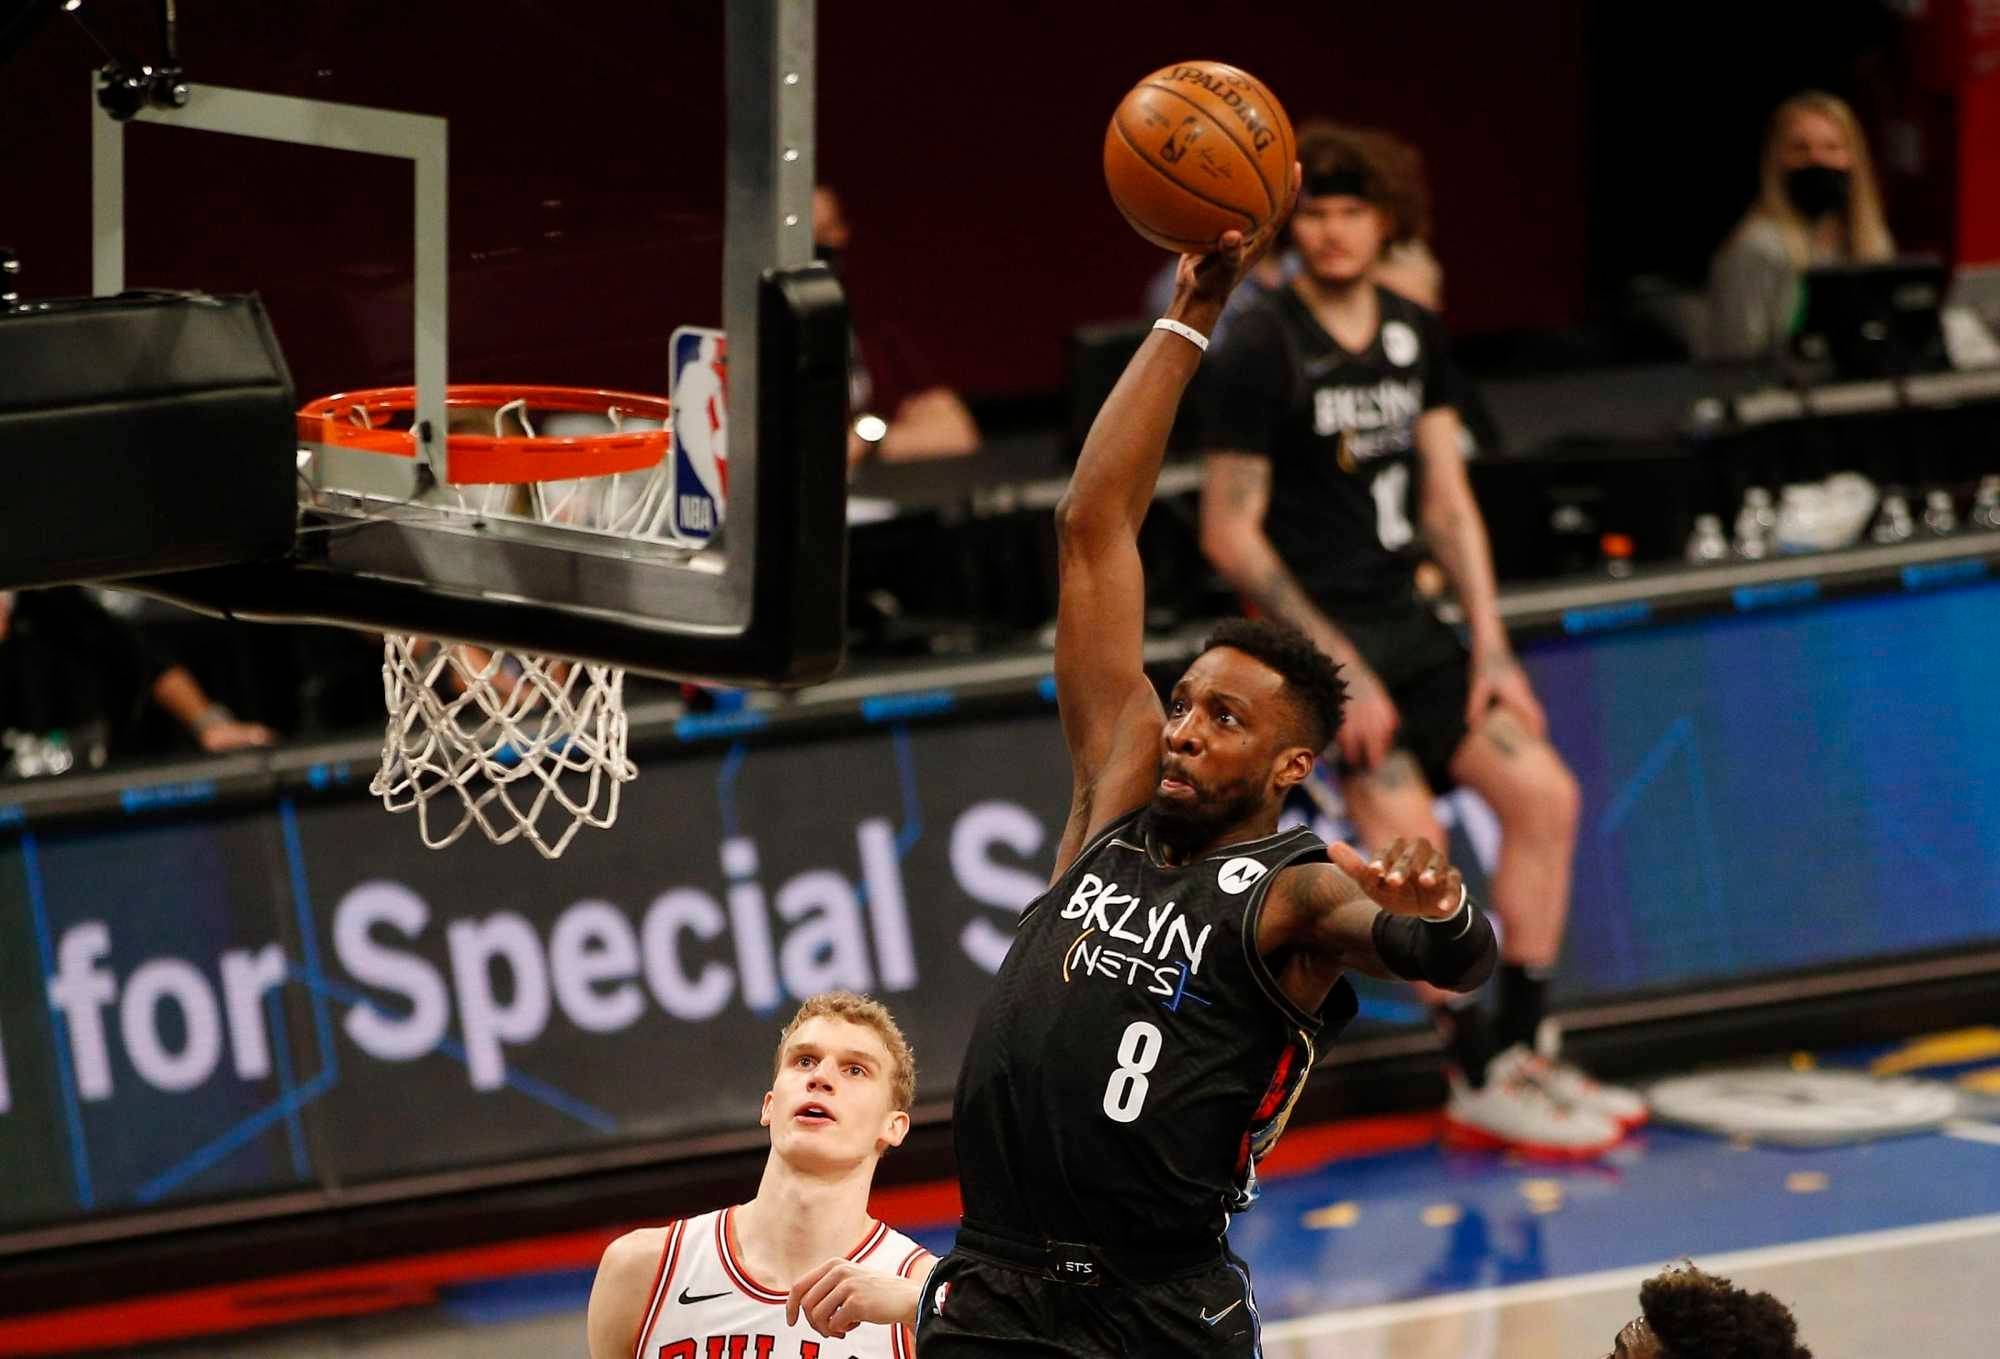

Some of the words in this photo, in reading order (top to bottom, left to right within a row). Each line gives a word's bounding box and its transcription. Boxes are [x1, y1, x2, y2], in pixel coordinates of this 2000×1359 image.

[1164, 66, 1275, 152] SPALDING
[48, 920, 288, 1101] for
[332, 818, 918, 1092] Special
[1061, 873, 1212, 975] BKLYN
[1071, 941, 1180, 996] NETS
[1103, 1021, 1163, 1123] 8
[1056, 1261, 1093, 1273] ETS
